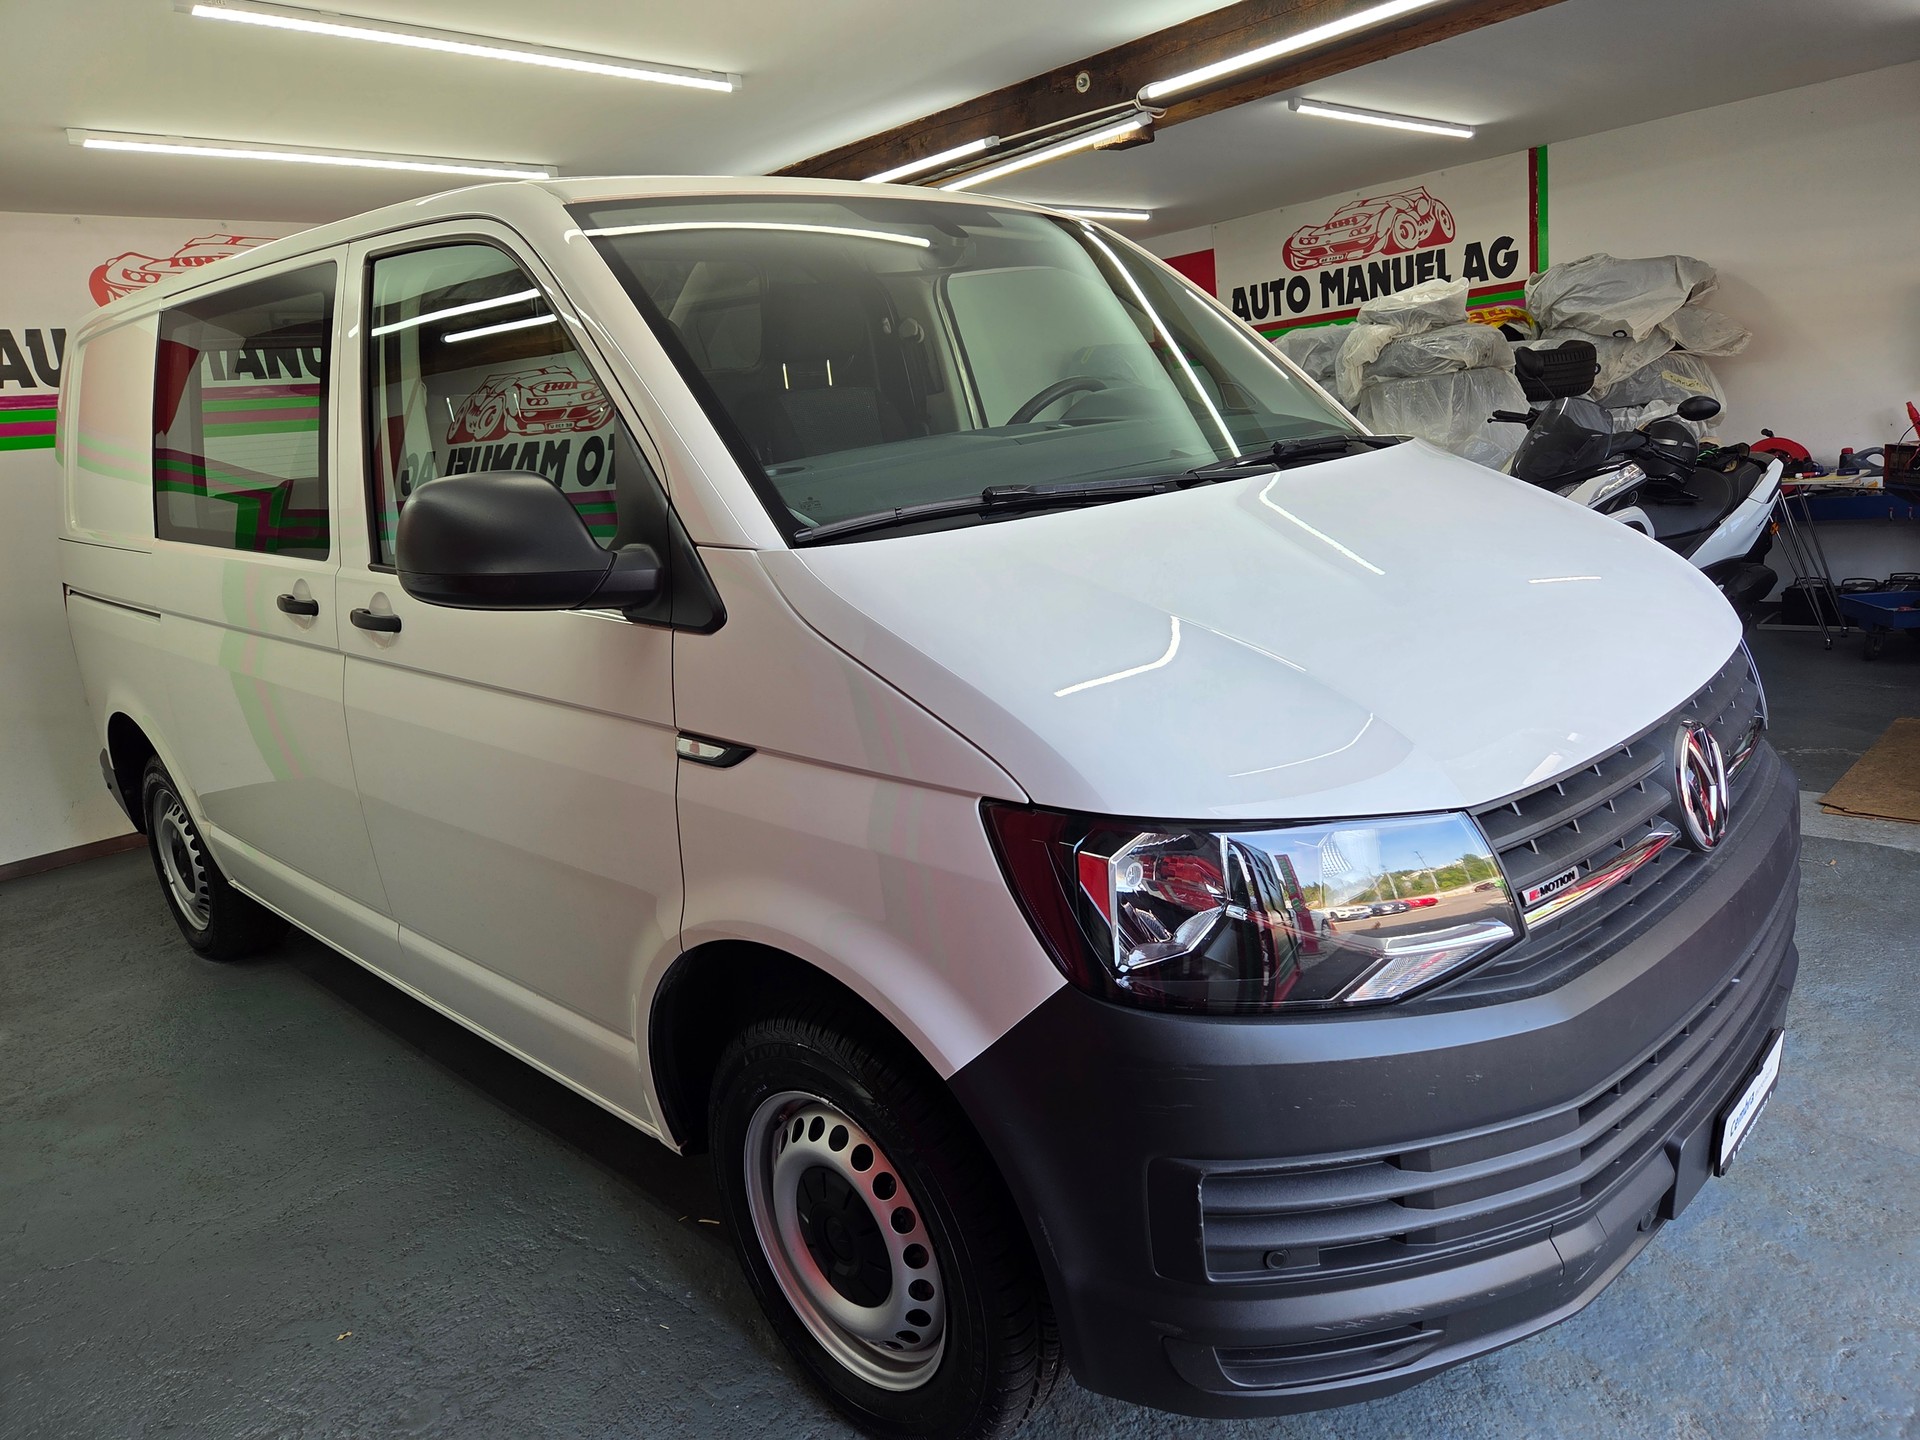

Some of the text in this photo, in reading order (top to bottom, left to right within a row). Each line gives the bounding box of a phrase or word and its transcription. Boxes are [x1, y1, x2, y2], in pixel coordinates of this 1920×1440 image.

[1232, 235, 1519, 322] AUTO MANUEL AG
